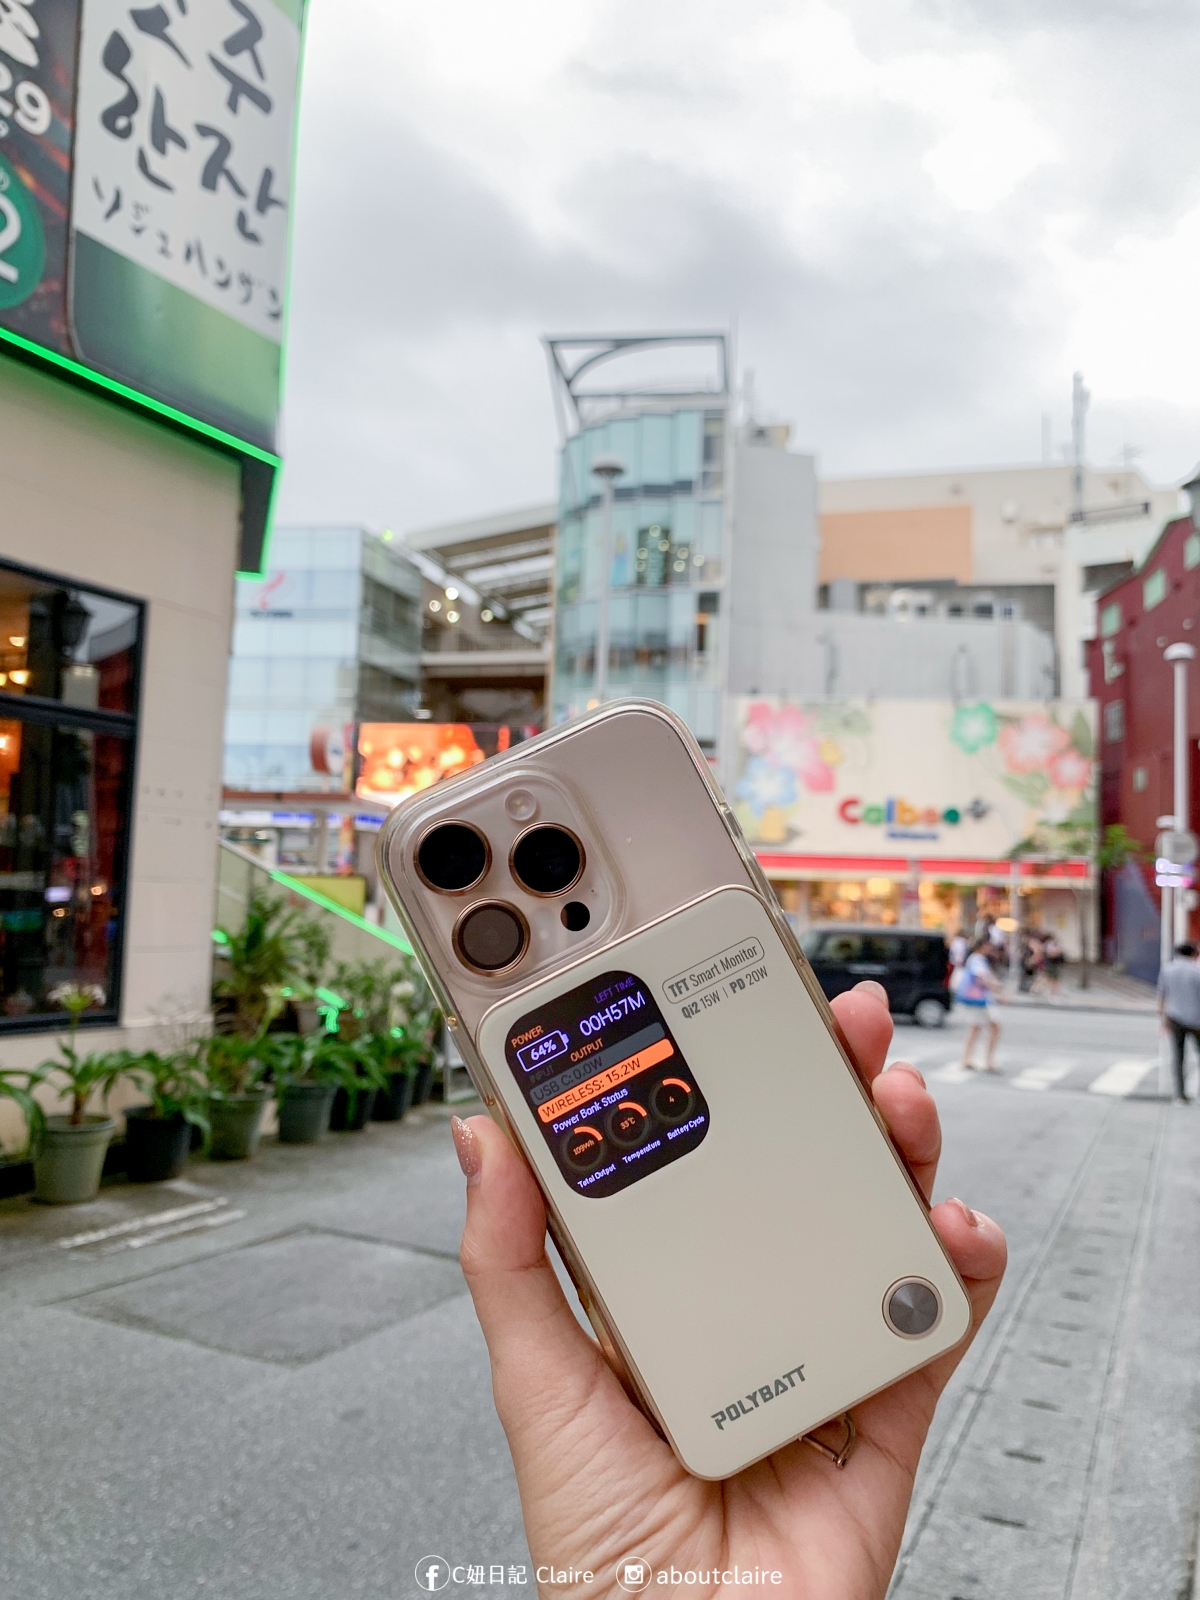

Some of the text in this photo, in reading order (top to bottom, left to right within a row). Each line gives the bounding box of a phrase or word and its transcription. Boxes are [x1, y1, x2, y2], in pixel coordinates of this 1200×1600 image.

[668, 945, 758, 998] TFT Smart Monitor
[594, 977, 635, 1004] LEFT TIME
[681, 965, 768, 1019] Qi2 15W PD 20W
[579, 991, 646, 1036] 00H57M
[511, 1025, 544, 1048] POWER
[531, 1039, 557, 1060] 64%
[570, 1038, 603, 1062] OUTPUT
[533, 1080, 560, 1101] USB
[542, 1057, 640, 1117] WIRELESS: 15.2W
[552, 1088, 628, 1133] Power Bank Status
[667, 1116, 705, 1140] Battery Cycle
[622, 1140, 661, 1163] Temperature
[577, 1163, 616, 1188] Total Output
[710, 1364, 806, 1431] POLYBATT
